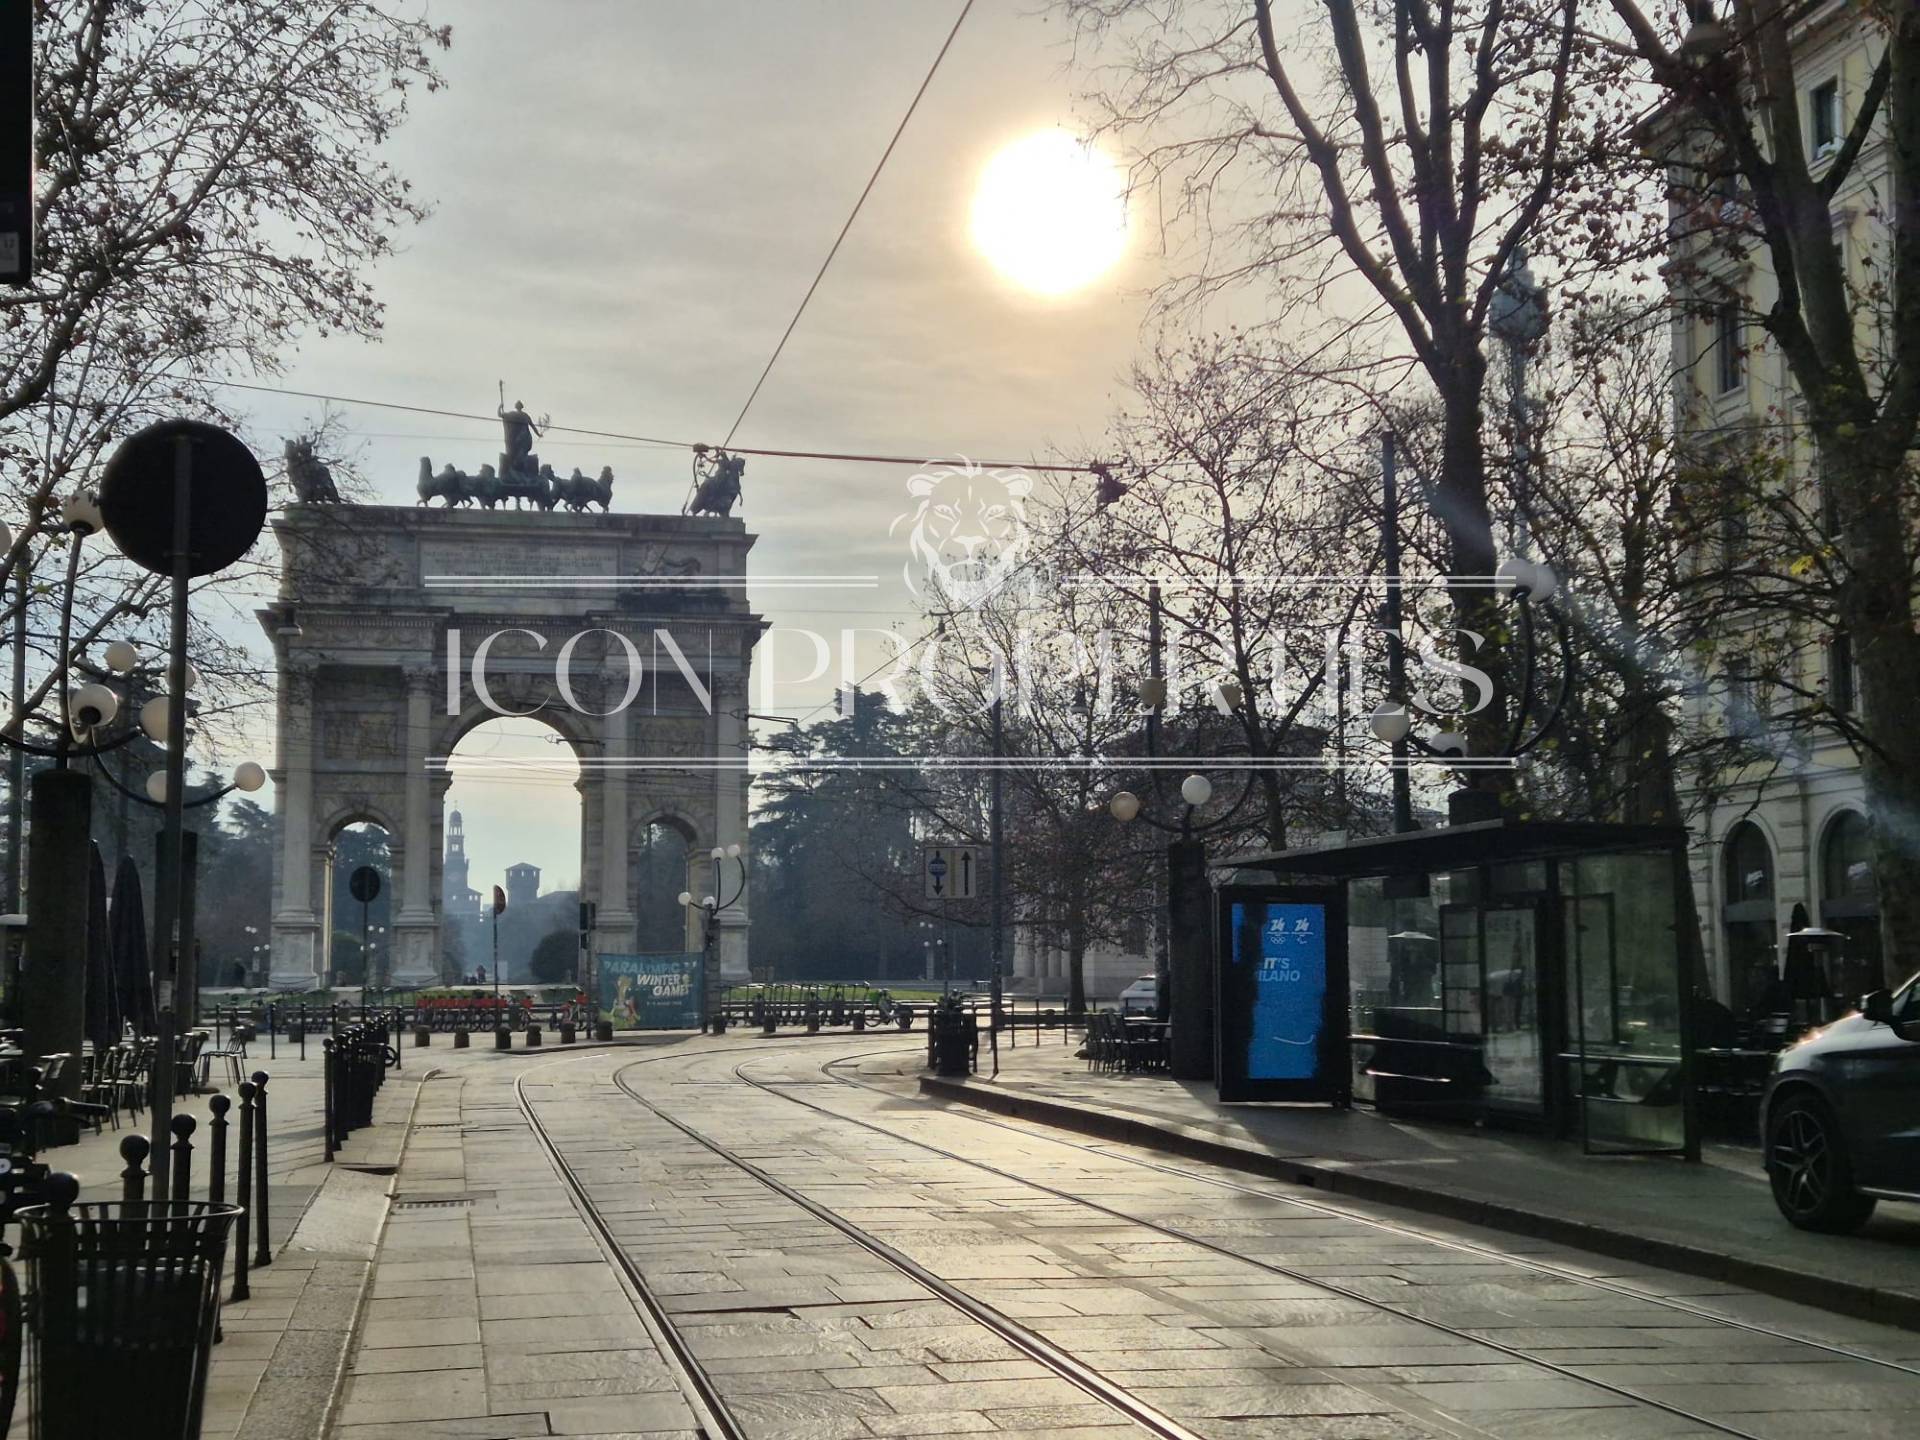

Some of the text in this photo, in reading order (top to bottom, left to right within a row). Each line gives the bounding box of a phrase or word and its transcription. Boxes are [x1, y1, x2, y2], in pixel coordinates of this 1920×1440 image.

[1263, 957, 1290, 970] IT'S
[637, 974, 681, 985] WINTER
[1257, 970, 1301, 982] ILANO
[652, 985, 690, 997] GAMES
